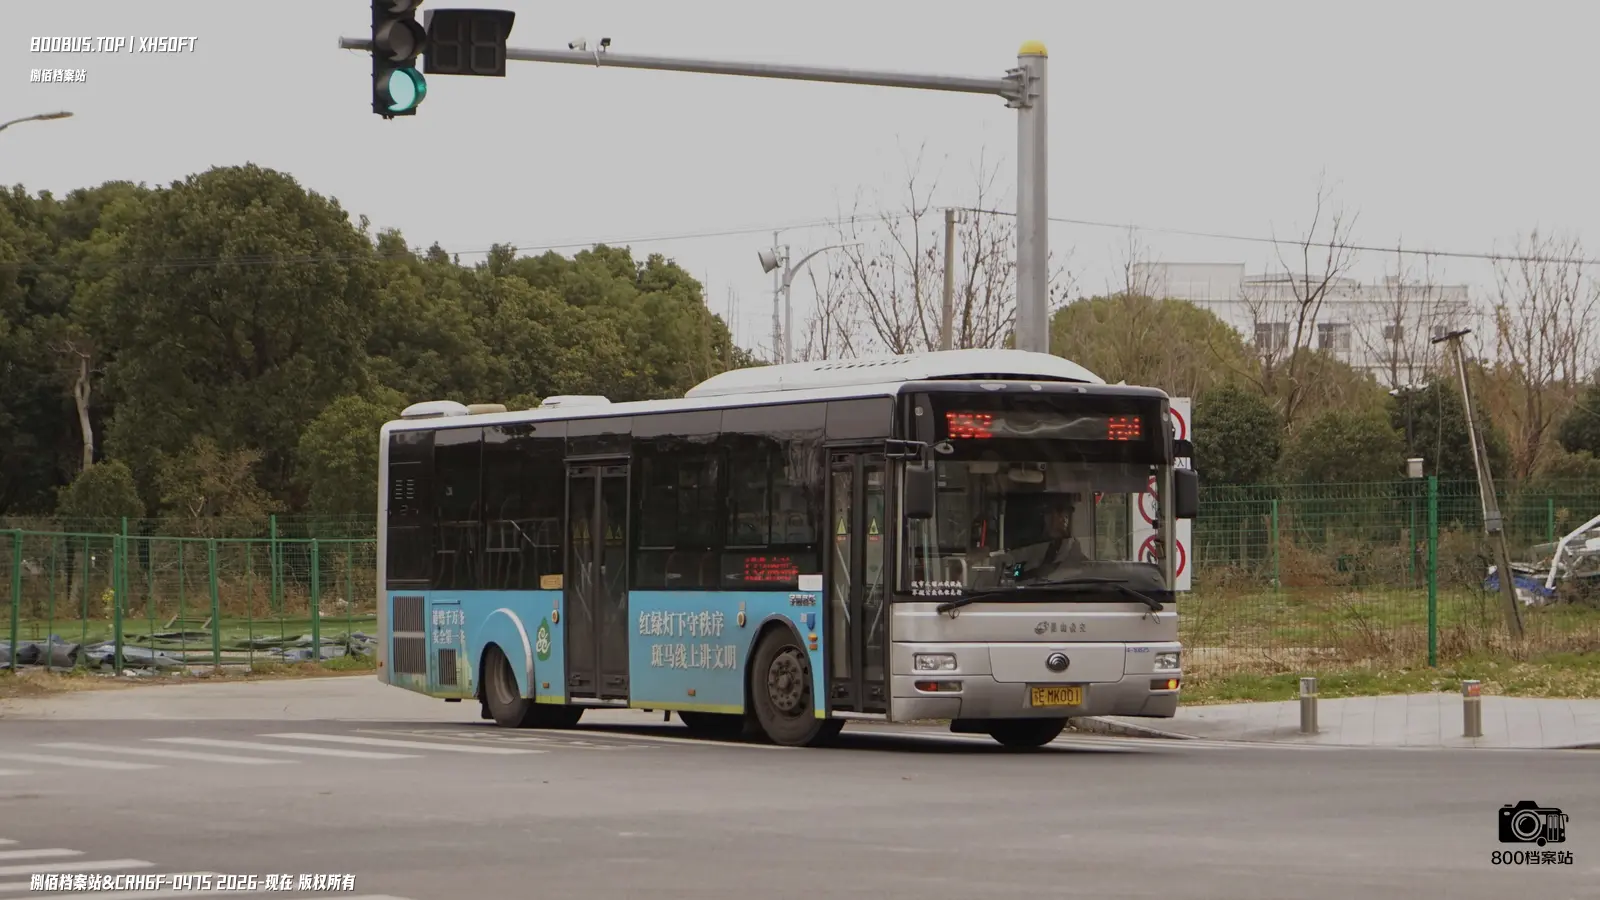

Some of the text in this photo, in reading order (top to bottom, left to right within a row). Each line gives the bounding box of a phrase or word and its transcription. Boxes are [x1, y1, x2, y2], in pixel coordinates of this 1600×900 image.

[639, 611, 725, 637] 红绿灯下守秩序
[651, 643, 738, 670] 斑马线上讲文明
